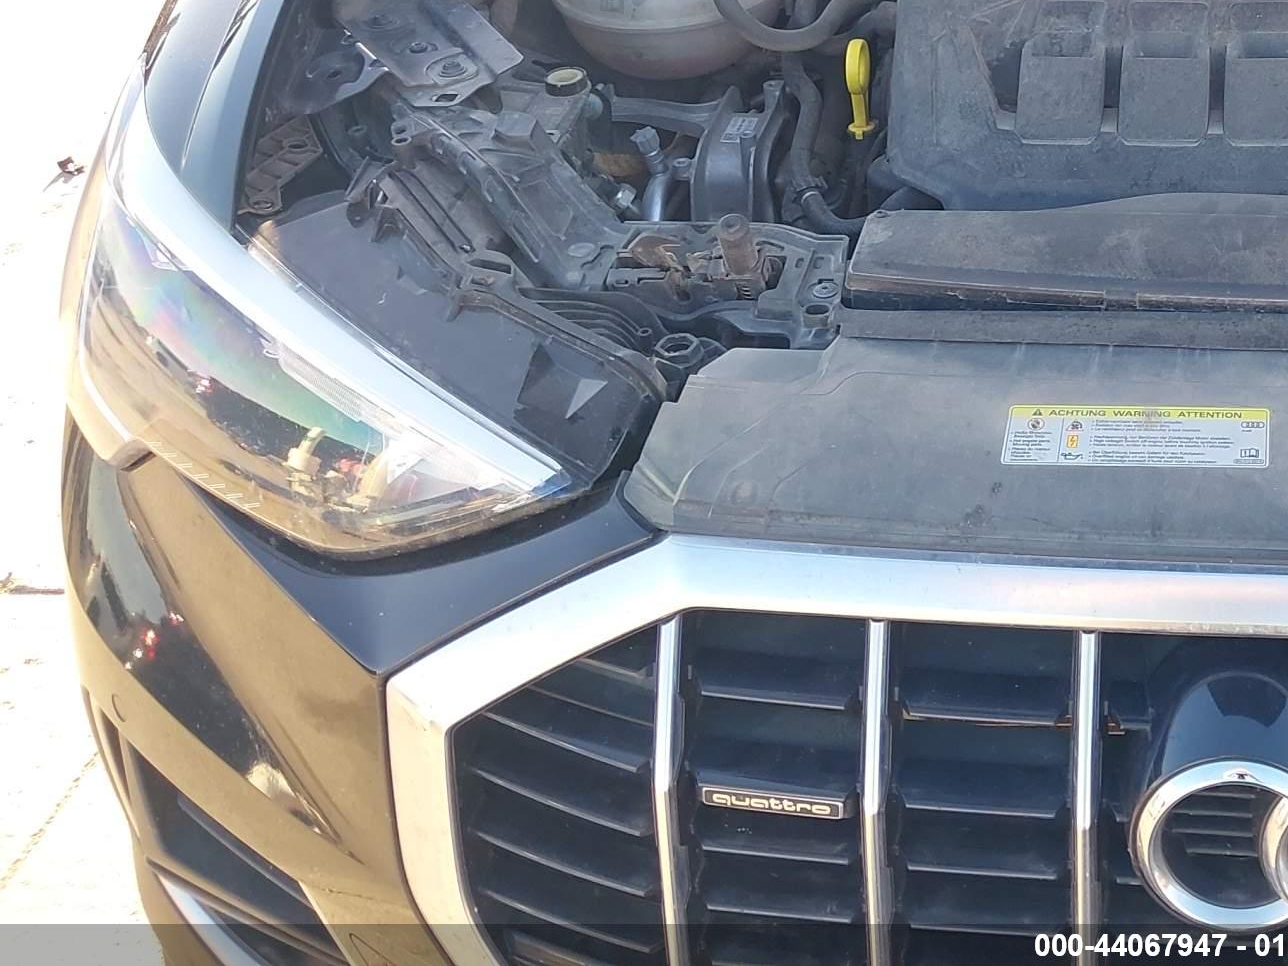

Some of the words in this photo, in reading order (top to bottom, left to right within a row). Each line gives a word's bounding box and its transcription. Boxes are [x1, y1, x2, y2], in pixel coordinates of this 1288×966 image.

[1049, 409, 1106, 417] ACHTUNG
[1113, 410, 1171, 418] WARNING
[1177, 411, 1242, 419] ATTENTION
[712, 793, 831, 815] quattro
